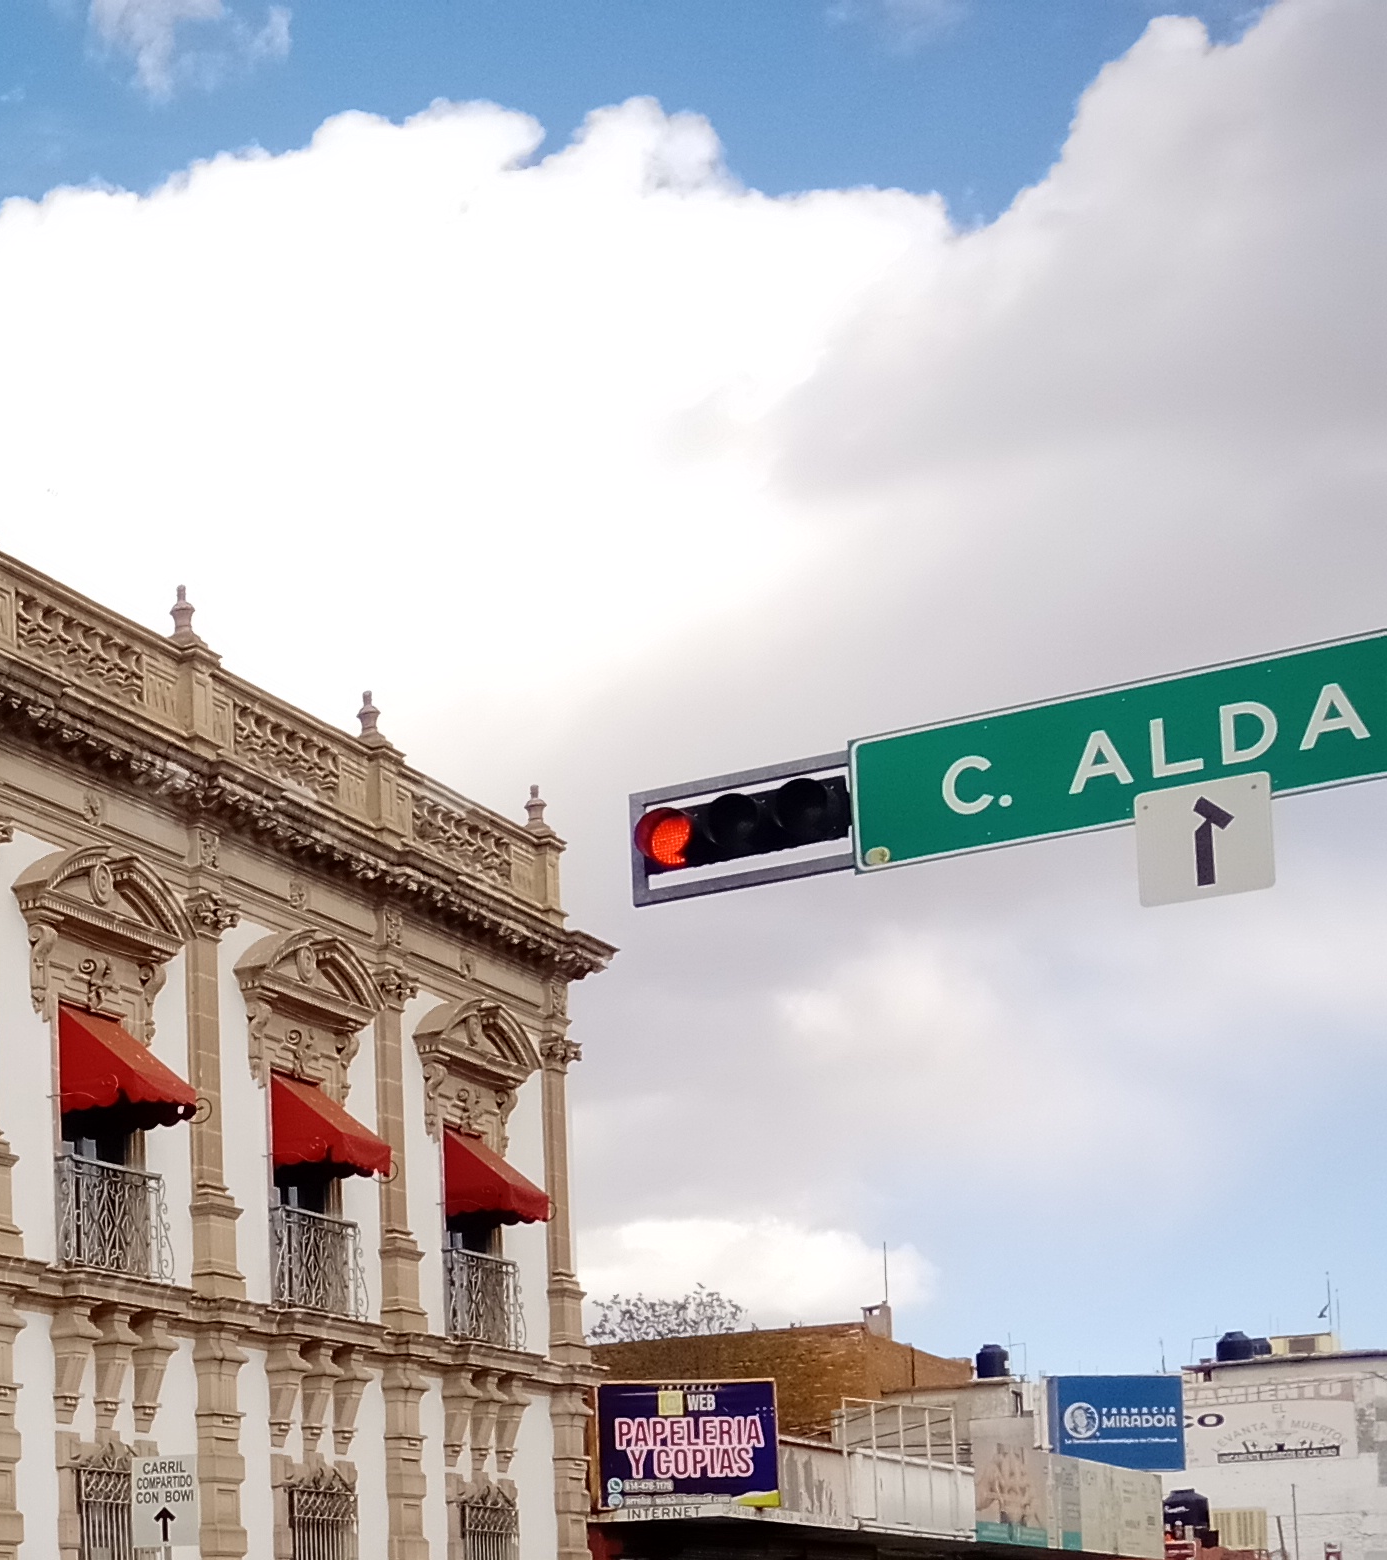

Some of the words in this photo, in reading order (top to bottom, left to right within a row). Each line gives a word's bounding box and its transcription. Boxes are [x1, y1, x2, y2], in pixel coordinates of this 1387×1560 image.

[942, 755, 1013, 815] C.
[1069, 683, 1371, 795] ALDA
[686, 1394, 716, 1411] WEB
[1271, 1403, 1287, 1414] EL
[1102, 1406, 1176, 1415] FARMACIA
[1102, 1415, 1177, 1428] MIRADOR
[615, 1416, 765, 1450] PAPELERIA
[1212, 1421, 1269, 1453] LEVANTA
[1290, 1418, 1349, 1447] MUERTOS
[142, 1461, 187, 1475] CARRIL
[628, 1446, 647, 1479] Y
[654, 1446, 754, 1479] COPIAS
[136, 1474, 193, 1489] COMPARTIDO
[136, 1491, 159, 1504] CON
[164, 1489, 194, 1503] BOWI
[627, 1506, 701, 1519] INTERNET
